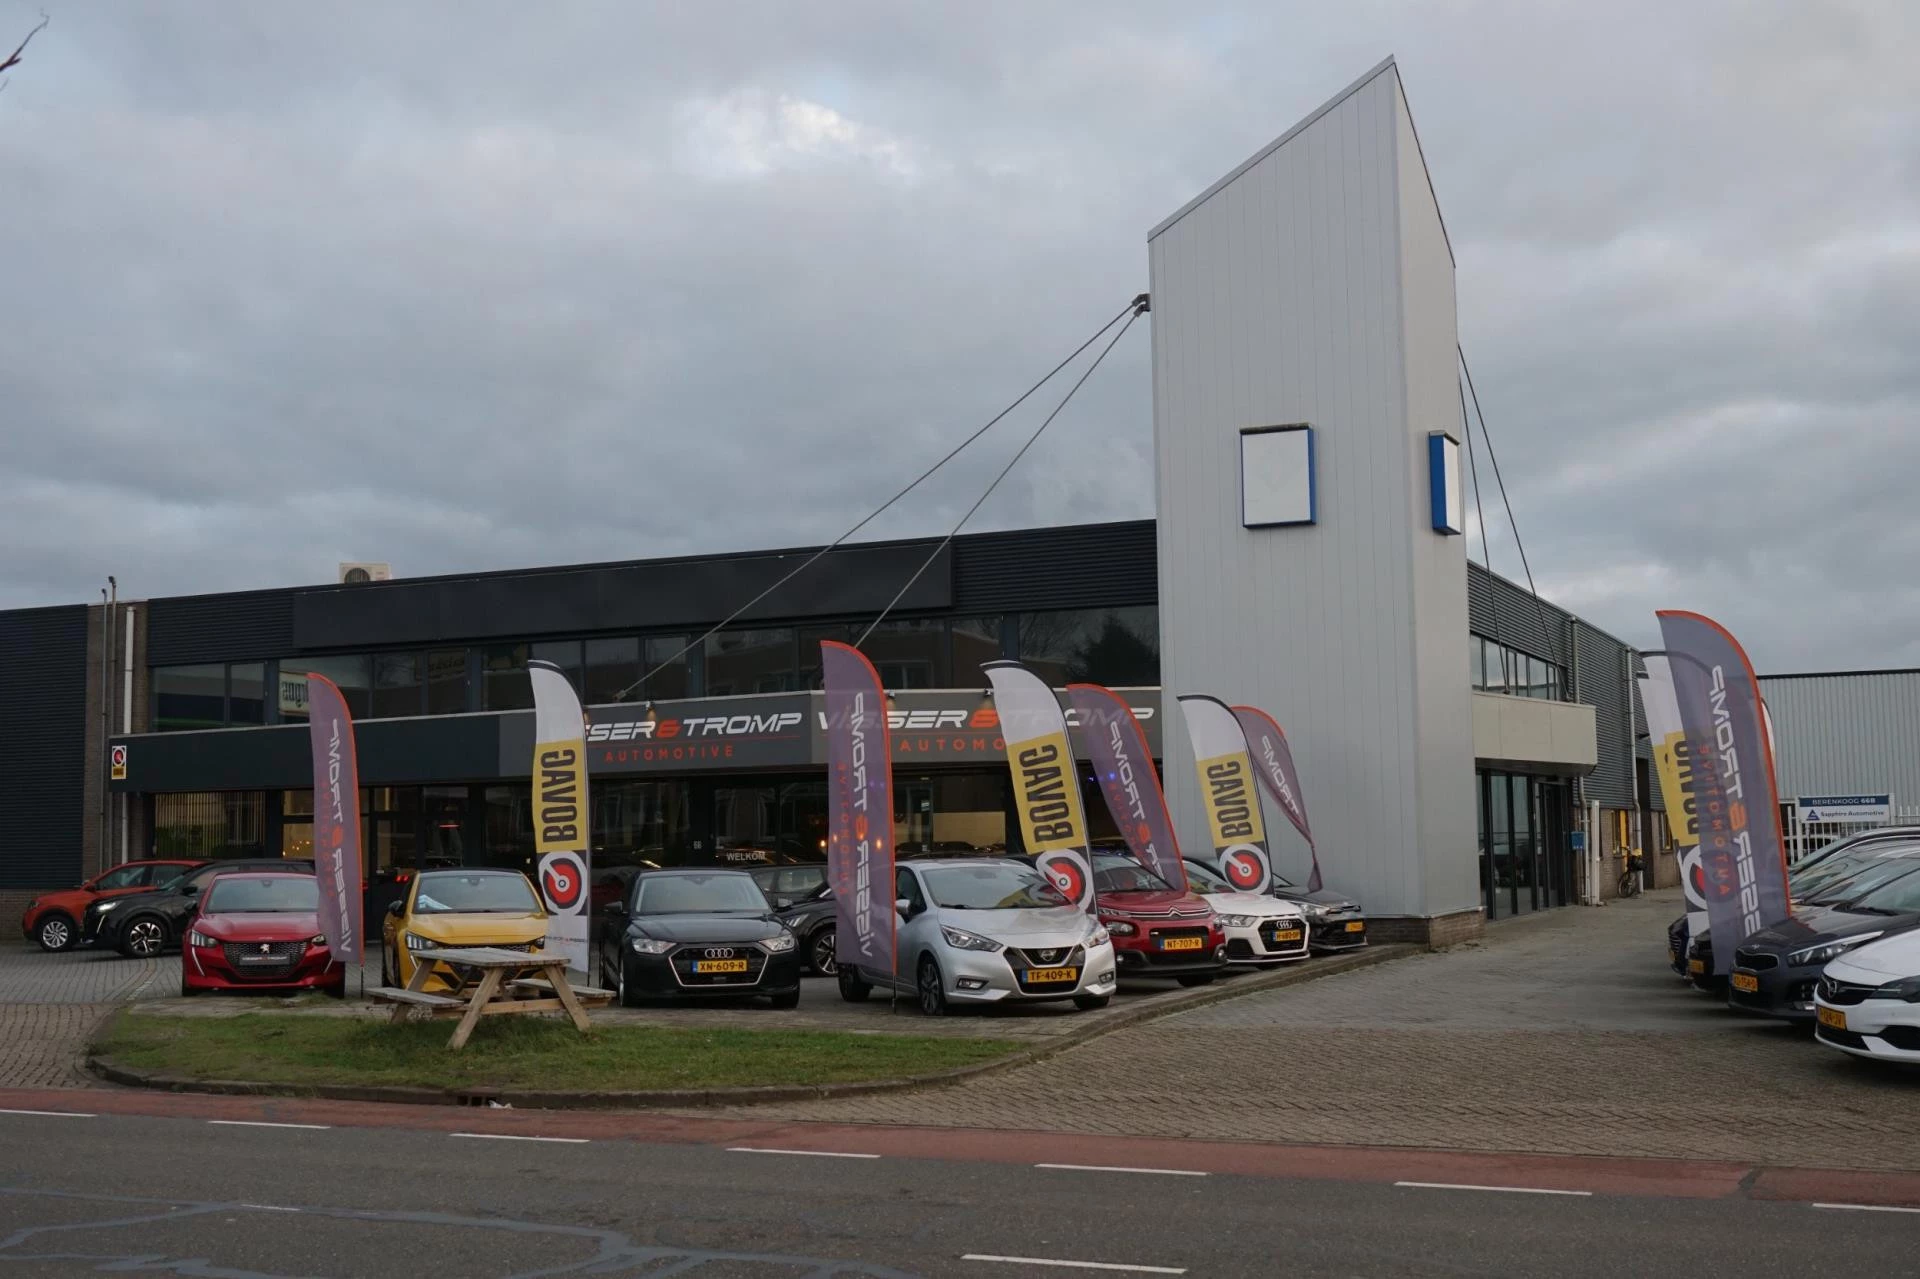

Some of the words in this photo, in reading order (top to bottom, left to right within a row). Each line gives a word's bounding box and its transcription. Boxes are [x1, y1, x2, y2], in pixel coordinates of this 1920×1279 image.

[682, 712, 802, 737] TROMP
[899, 738, 1006, 752] AUTOMO
[604, 745, 734, 762] AUTOMOTIVE
[1030, 970, 1072, 981] TF-409-K
